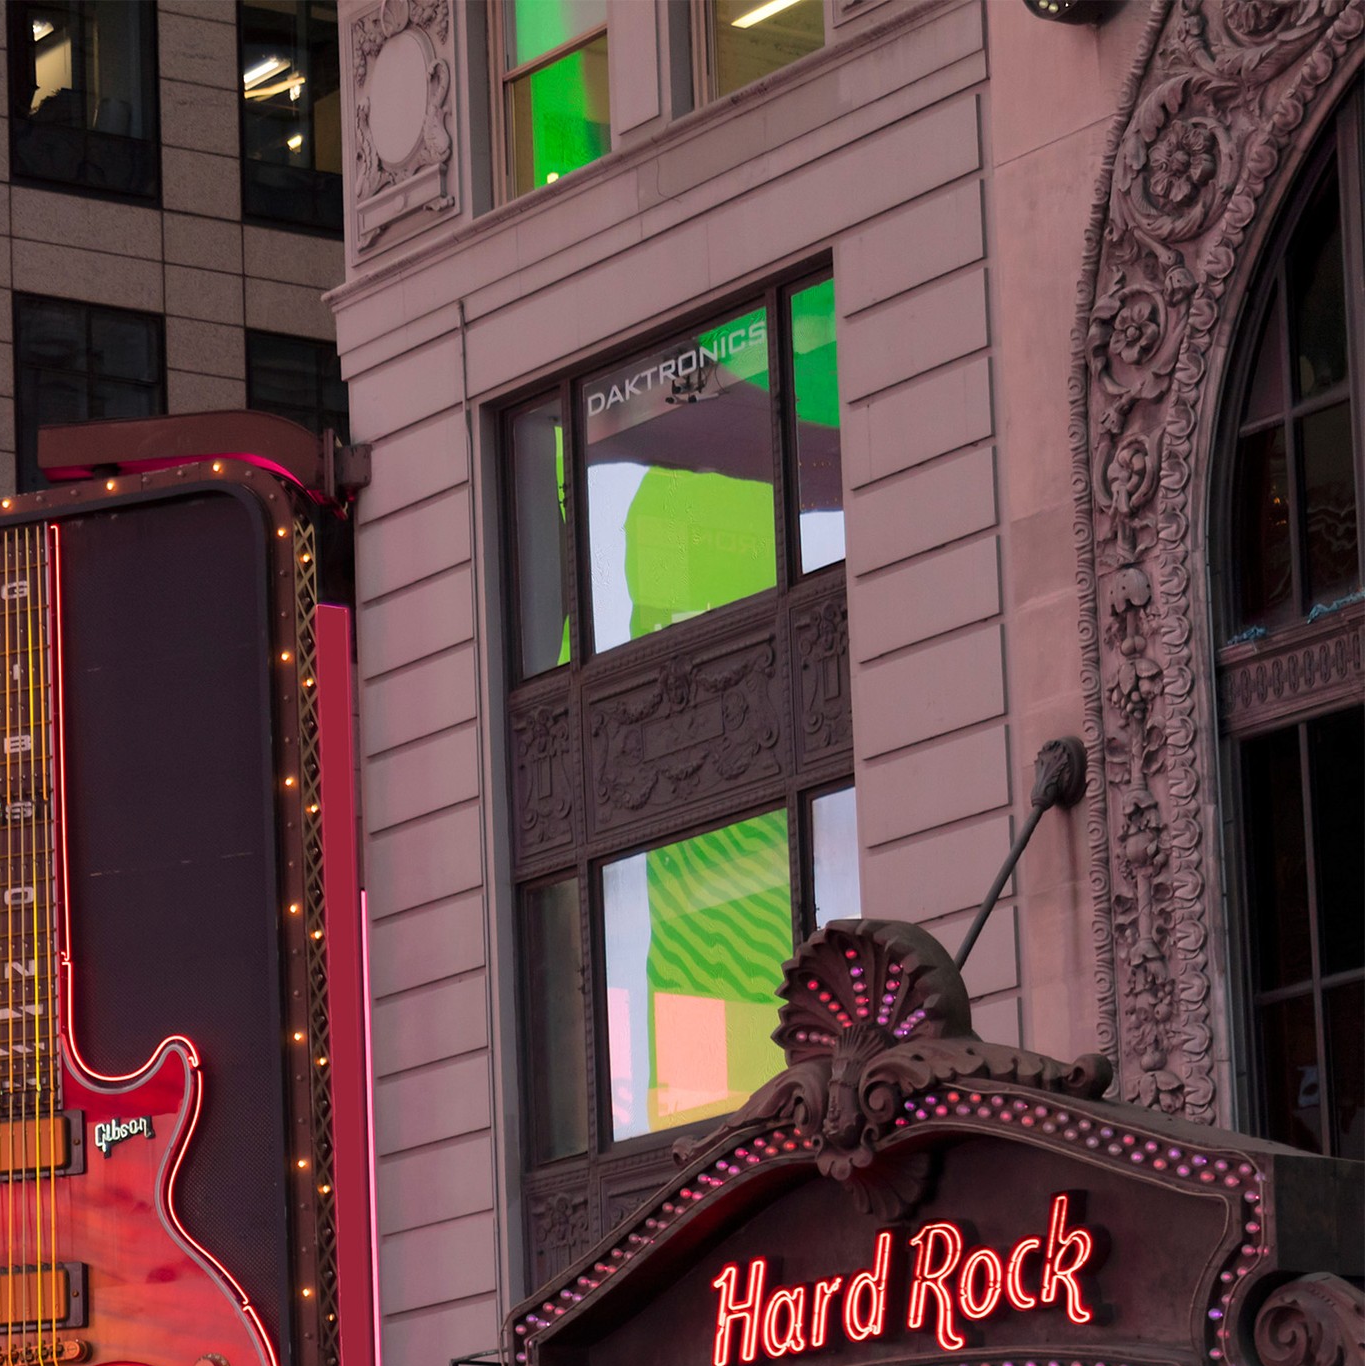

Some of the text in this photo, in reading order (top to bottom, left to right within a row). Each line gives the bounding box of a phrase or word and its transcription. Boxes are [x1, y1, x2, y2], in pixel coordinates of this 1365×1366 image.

[586, 318, 768, 419] DAKTRONICS
[94, 1113, 153, 1152] Gibson
[907, 1191, 1094, 1352] Rock
